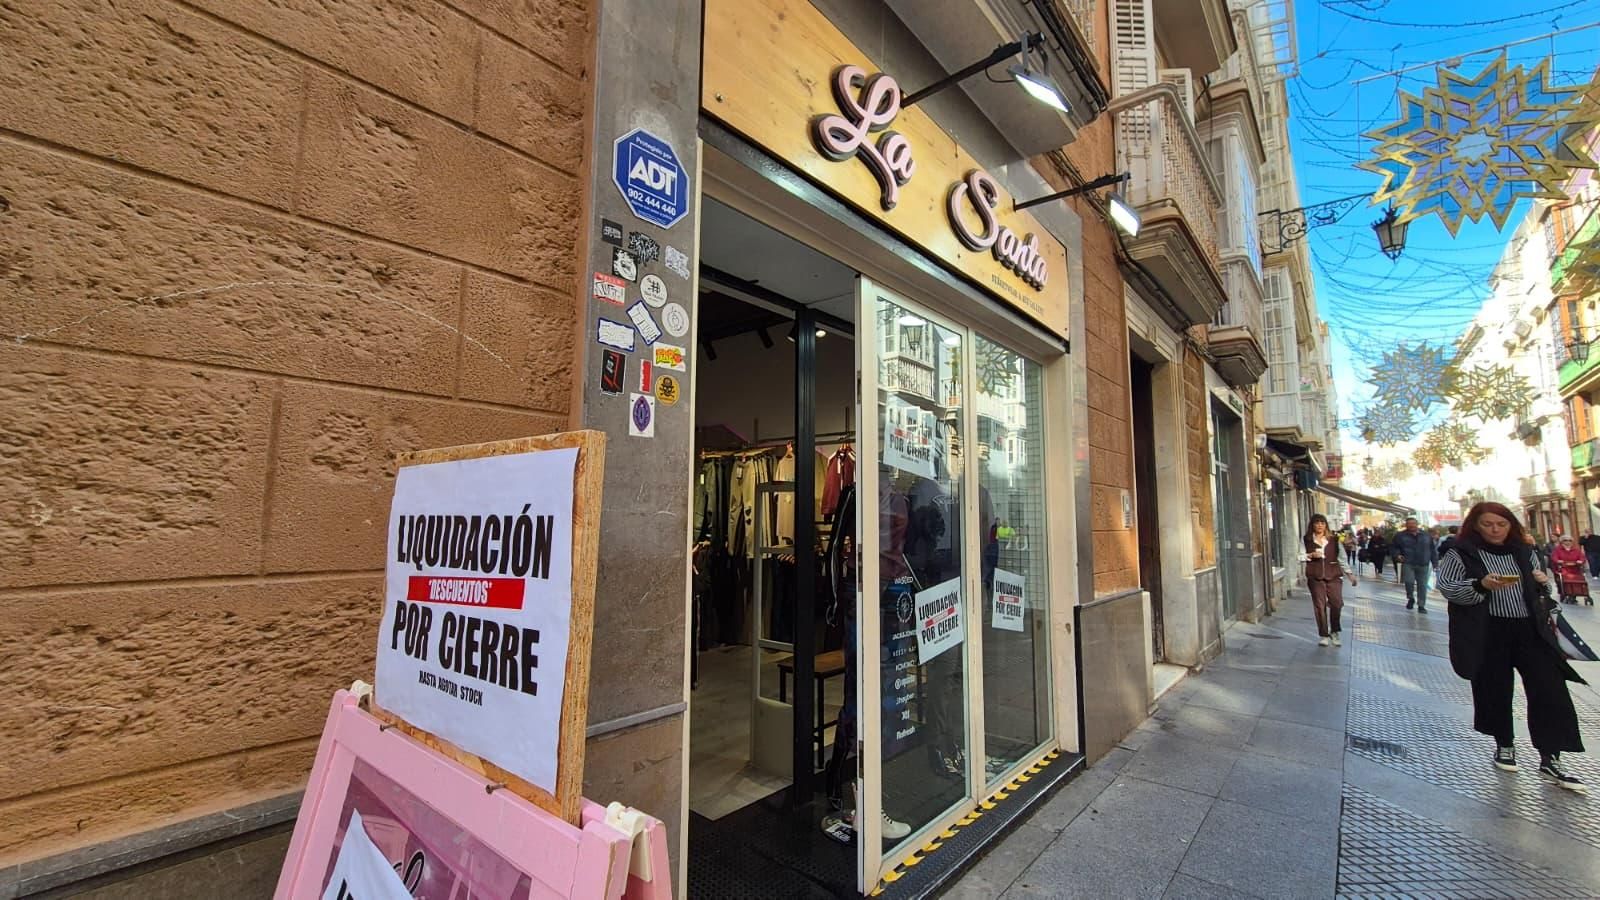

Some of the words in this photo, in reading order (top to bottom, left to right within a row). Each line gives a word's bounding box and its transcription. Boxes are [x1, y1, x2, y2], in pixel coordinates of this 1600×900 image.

[630, 156, 676, 196] ADT
[812, 64, 915, 211] La
[946, 169, 1048, 292] Santa
[627, 187, 644, 202] 902
[645, 197, 660, 210] 444
[661, 203, 677, 216] 440
[397, 504, 554, 580] LIQUIDACIÓN
[918, 590, 959, 621] LIQUIDACIÓN
[995, 601, 1005, 614] POR
[921, 625, 936, 645] POR
[938, 614, 959, 637] CIERRE
[391, 600, 433, 661] POR
[438, 611, 540, 697] CIERRE
[418, 669, 437, 689] HASTA
[437, 674, 458, 698] AGOTAR
[460, 685, 483, 706] STOCK
